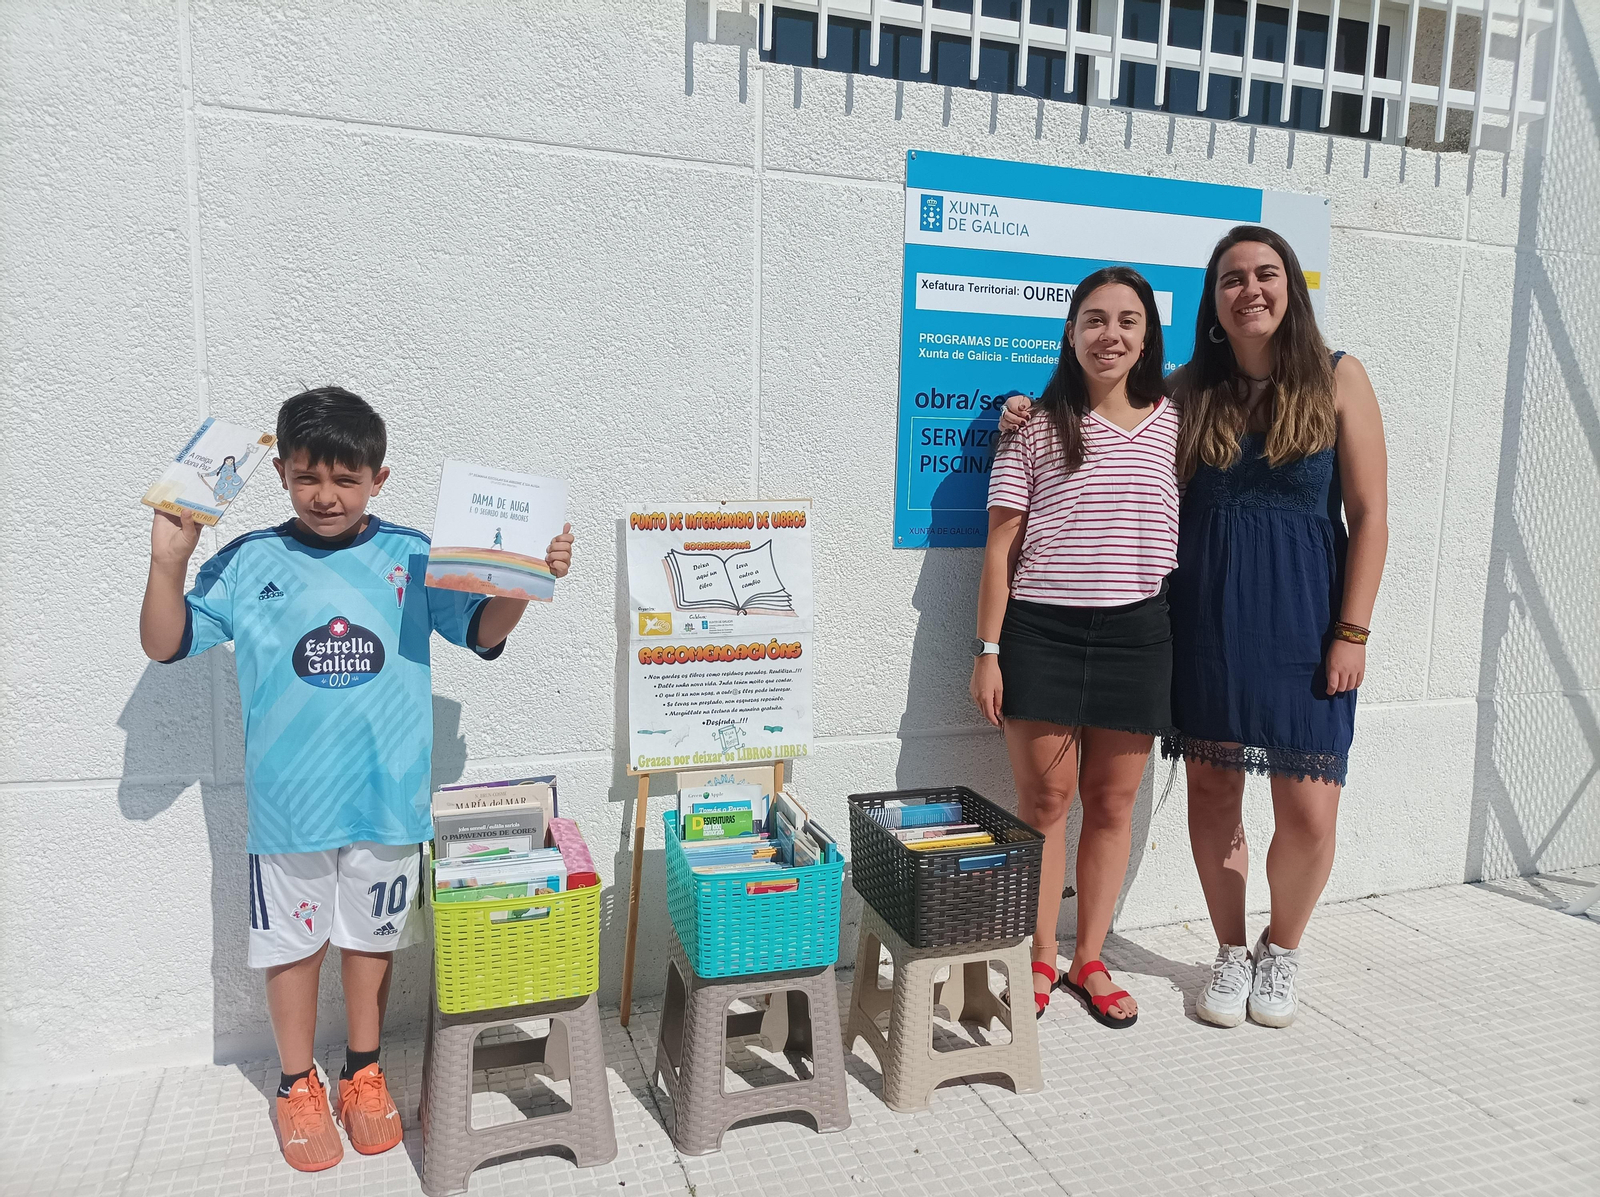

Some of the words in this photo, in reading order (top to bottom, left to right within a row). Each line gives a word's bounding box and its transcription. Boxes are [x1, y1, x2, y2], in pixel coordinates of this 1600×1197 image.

[949, 200, 999, 217] XUNTA
[948, 217, 966, 231] DE
[972, 219, 1029, 237] GALICIA
[921, 279, 965, 292] Xefatura
[967, 282, 1020, 295] Territorial:
[1023, 286, 1075, 302] OUREN
[919, 332, 991, 347] PROGRAMAS
[994, 337, 1009, 348] DE
[1011, 338, 1062, 350] COOPERA
[918, 347, 949, 359] Xunta
[952, 349, 964, 360] de
[967, 350, 1002, 361] Galicia
[1011, 352, 1060, 364] Entidades
[472, 493, 494, 507] DAMA
[496, 497, 506, 510] DE
[510, 500, 530, 514] AUGA
[192, 512, 212, 522] ASTRO
[630, 512, 667, 531] PUNTO
[669, 512, 684, 530] DE
[685, 510, 754, 530] INTERCAMBIO
[756, 511, 770, 530] DE
[771, 510, 807, 530] LIBROS
[693, 562, 710, 571] Deixa
[738, 570, 754, 579] outro
[699, 582, 713, 590] libro
[742, 580, 761, 588] cambio
[258, 591, 284, 600] adidas
[304, 638, 374, 656] Estrella
[638, 638, 802, 665] RECOMENDACIÓNS
[308, 654, 371, 674] Galicia
[329, 672, 350, 688] 0,0
[638, 754, 672, 768] Grazas
[693, 751, 723, 764] deixar
[724, 751, 735, 762] os
[737, 746, 772, 761] LIBROS
[774, 744, 808, 758] LIBRES
[455, 799, 486, 809] MARÍA
[505, 797, 527, 805] MAR
[692, 815, 736, 830] DESVENTURAS
[450, 831, 497, 840] PAPAVENTOS
[368, 874, 408, 918] 10
